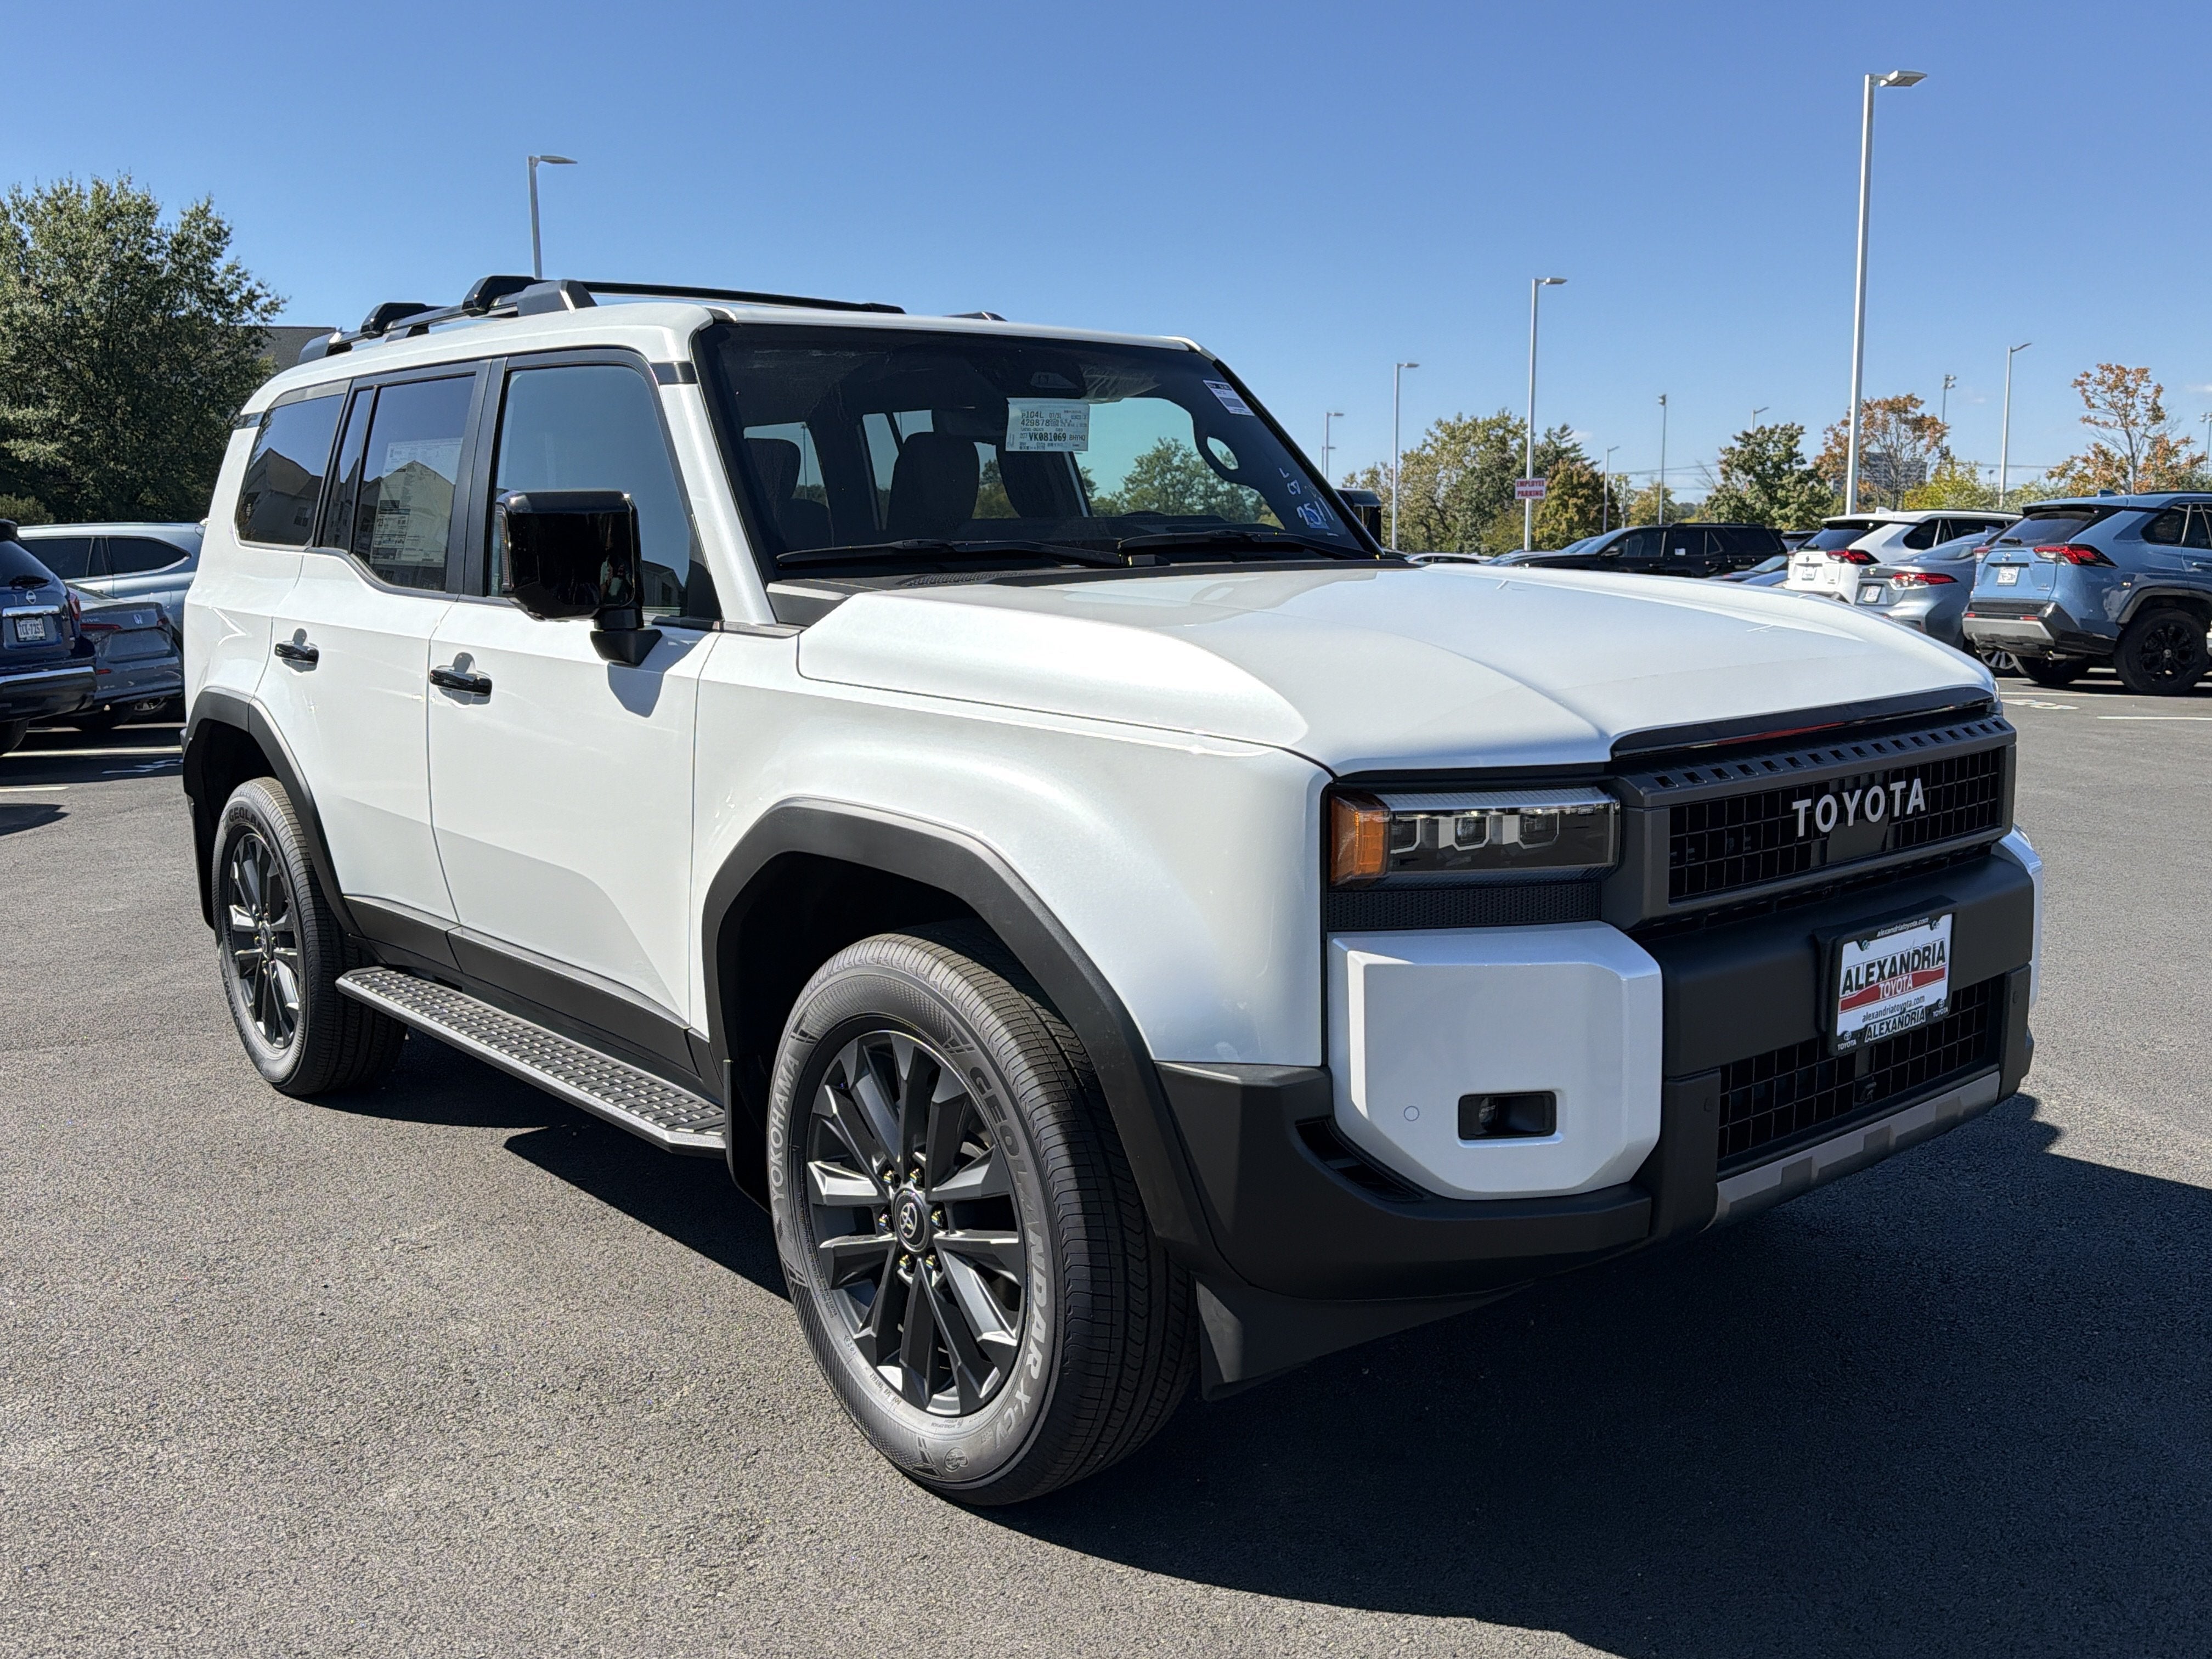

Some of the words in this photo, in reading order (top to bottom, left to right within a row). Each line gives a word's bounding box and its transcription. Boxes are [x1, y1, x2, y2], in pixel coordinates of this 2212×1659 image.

[1028, 432, 1066, 441] VK081069
[1792, 777, 1926, 838] TOYOTA
[1841, 939, 1946, 996] ALEXANDRIA
[1878, 974, 1914, 1000] TOYOTA
[1861, 995, 1925, 1023] alexandriatoyota.com
[1865, 1007, 1926, 1042] ALEXANDRIA
[1837, 1039, 1857, 1051] TOYOTA
[770, 1051, 800, 1202] YOKOHAMA
[969, 1066, 1047, 1380] GEOLANDAR
